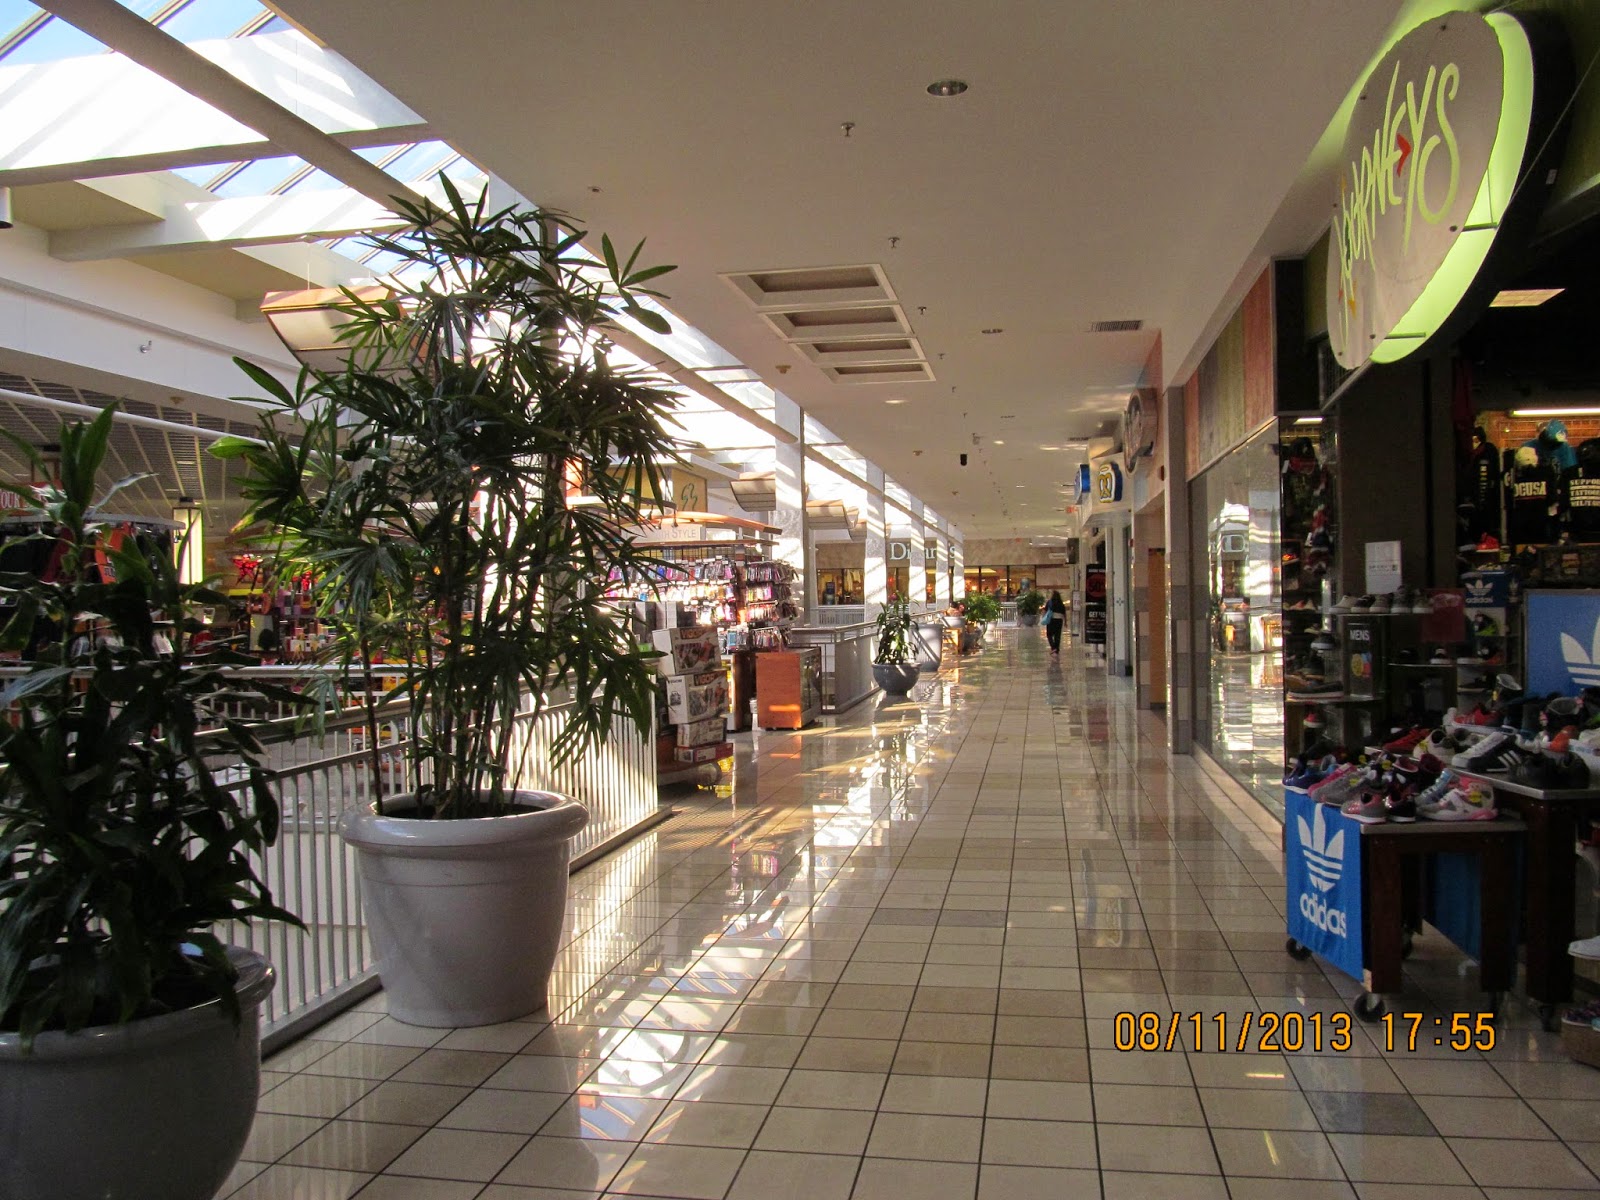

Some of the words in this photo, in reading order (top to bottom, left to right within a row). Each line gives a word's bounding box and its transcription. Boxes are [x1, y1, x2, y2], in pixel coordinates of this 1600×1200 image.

[671, 527, 696, 539] STYLE
[1349, 629, 1370, 641] MENS
[1299, 892, 1347, 939] adidas
